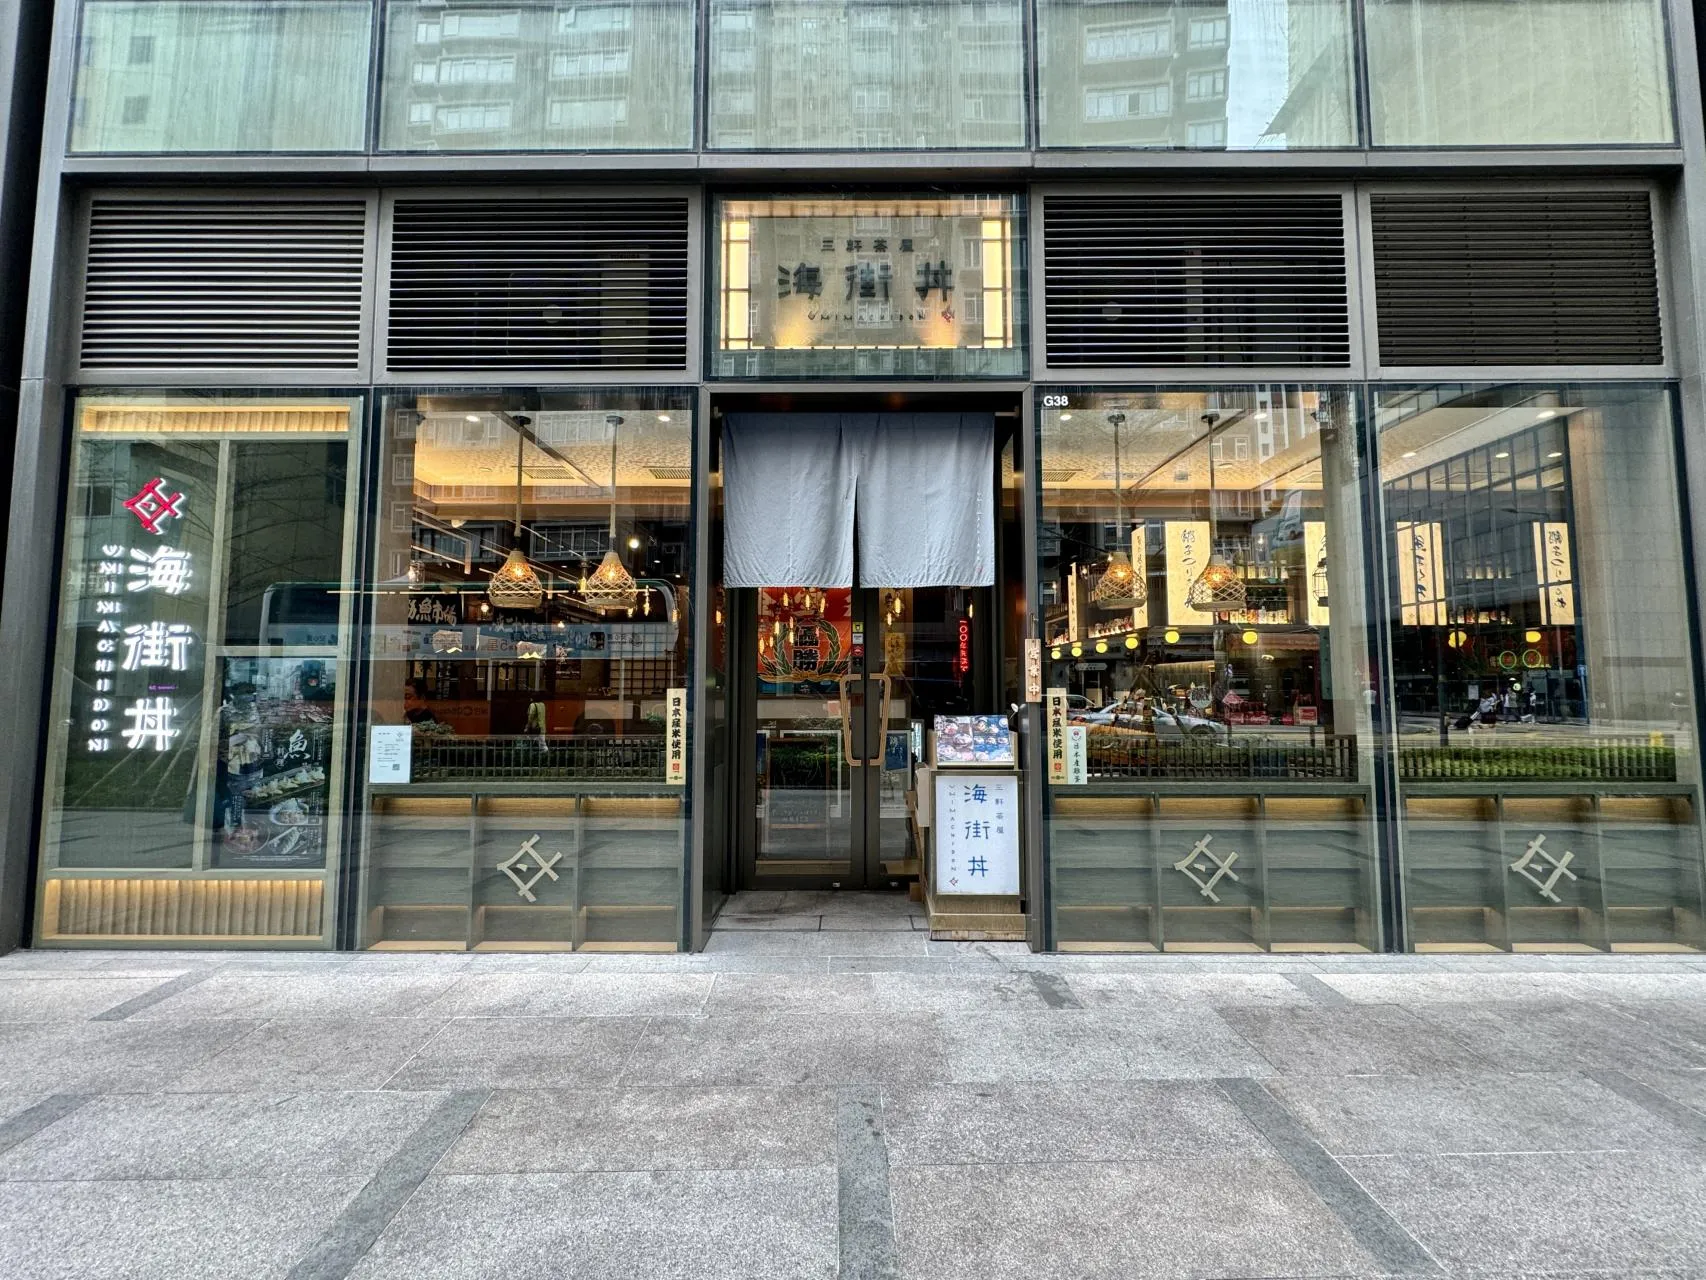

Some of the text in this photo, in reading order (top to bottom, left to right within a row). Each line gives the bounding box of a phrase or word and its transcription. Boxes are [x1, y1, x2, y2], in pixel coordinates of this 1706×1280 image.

[821, 238, 914, 252] 三軒茶屋
[778, 260, 955, 302] 海街丼
[1043, 395, 1069, 407] G38
[88, 545, 124, 751] UMIMACHIDON
[122, 545, 193, 751] 海街丼
[284, 729, 310, 760] 魚
[964, 784, 990, 877] 海街丼
